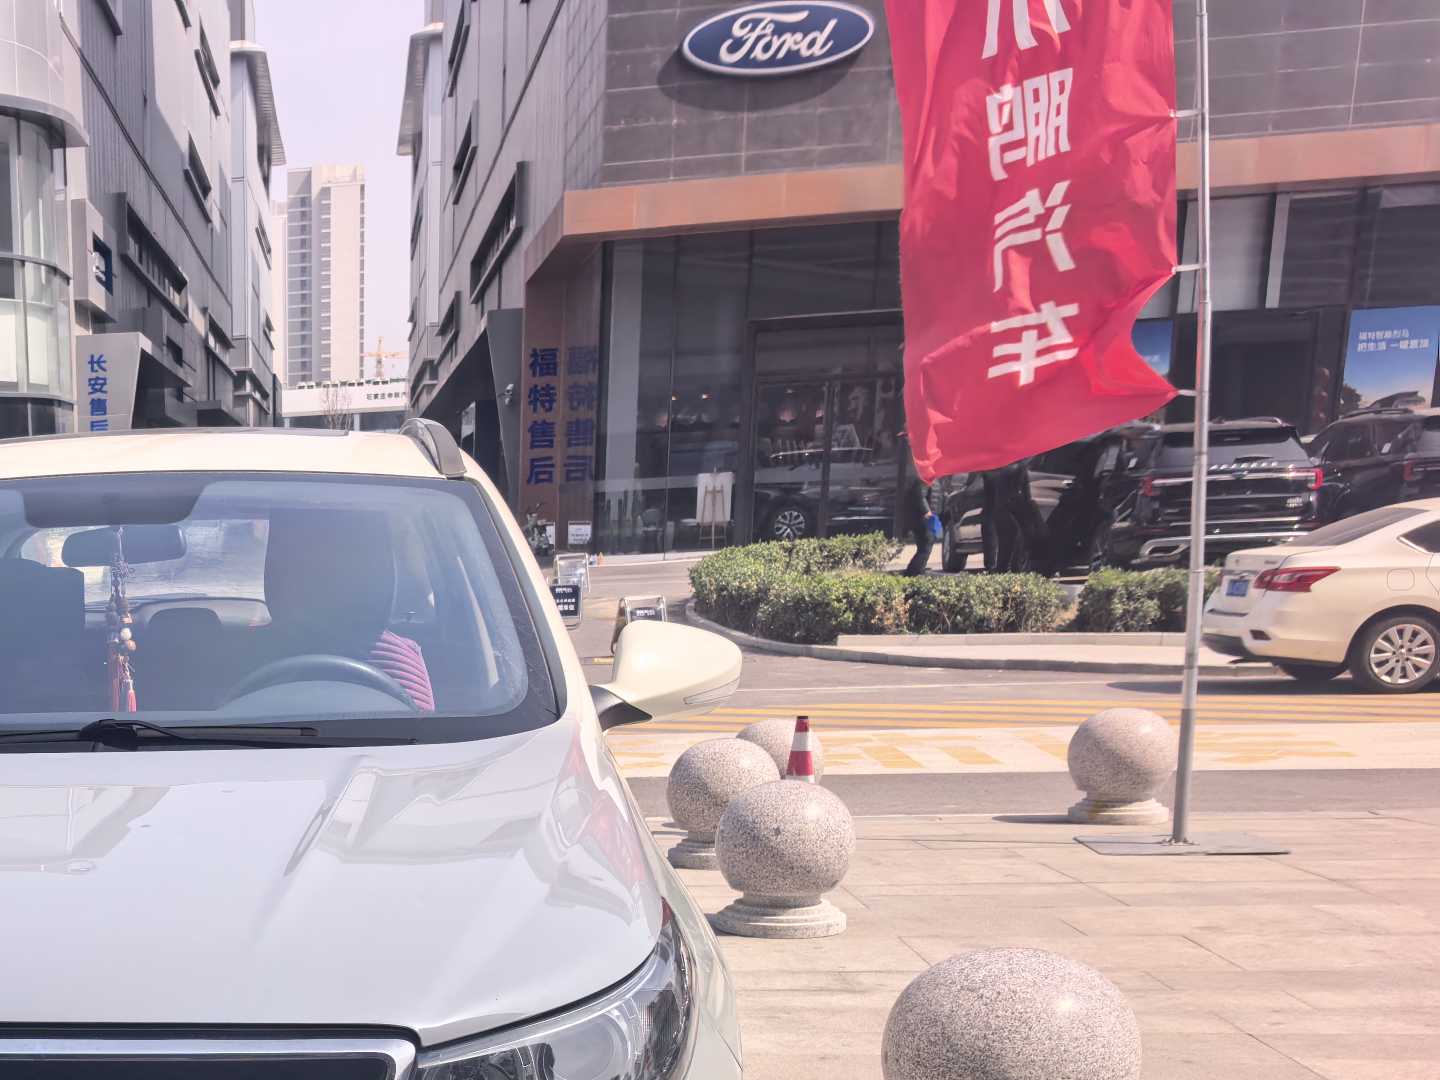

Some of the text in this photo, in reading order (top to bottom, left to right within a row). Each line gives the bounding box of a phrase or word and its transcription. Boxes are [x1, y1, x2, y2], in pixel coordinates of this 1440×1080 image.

[719, 10, 838, 63] Ford
[88, 354, 108, 432] 长安售后
[528, 348, 559, 484] 福特售后
